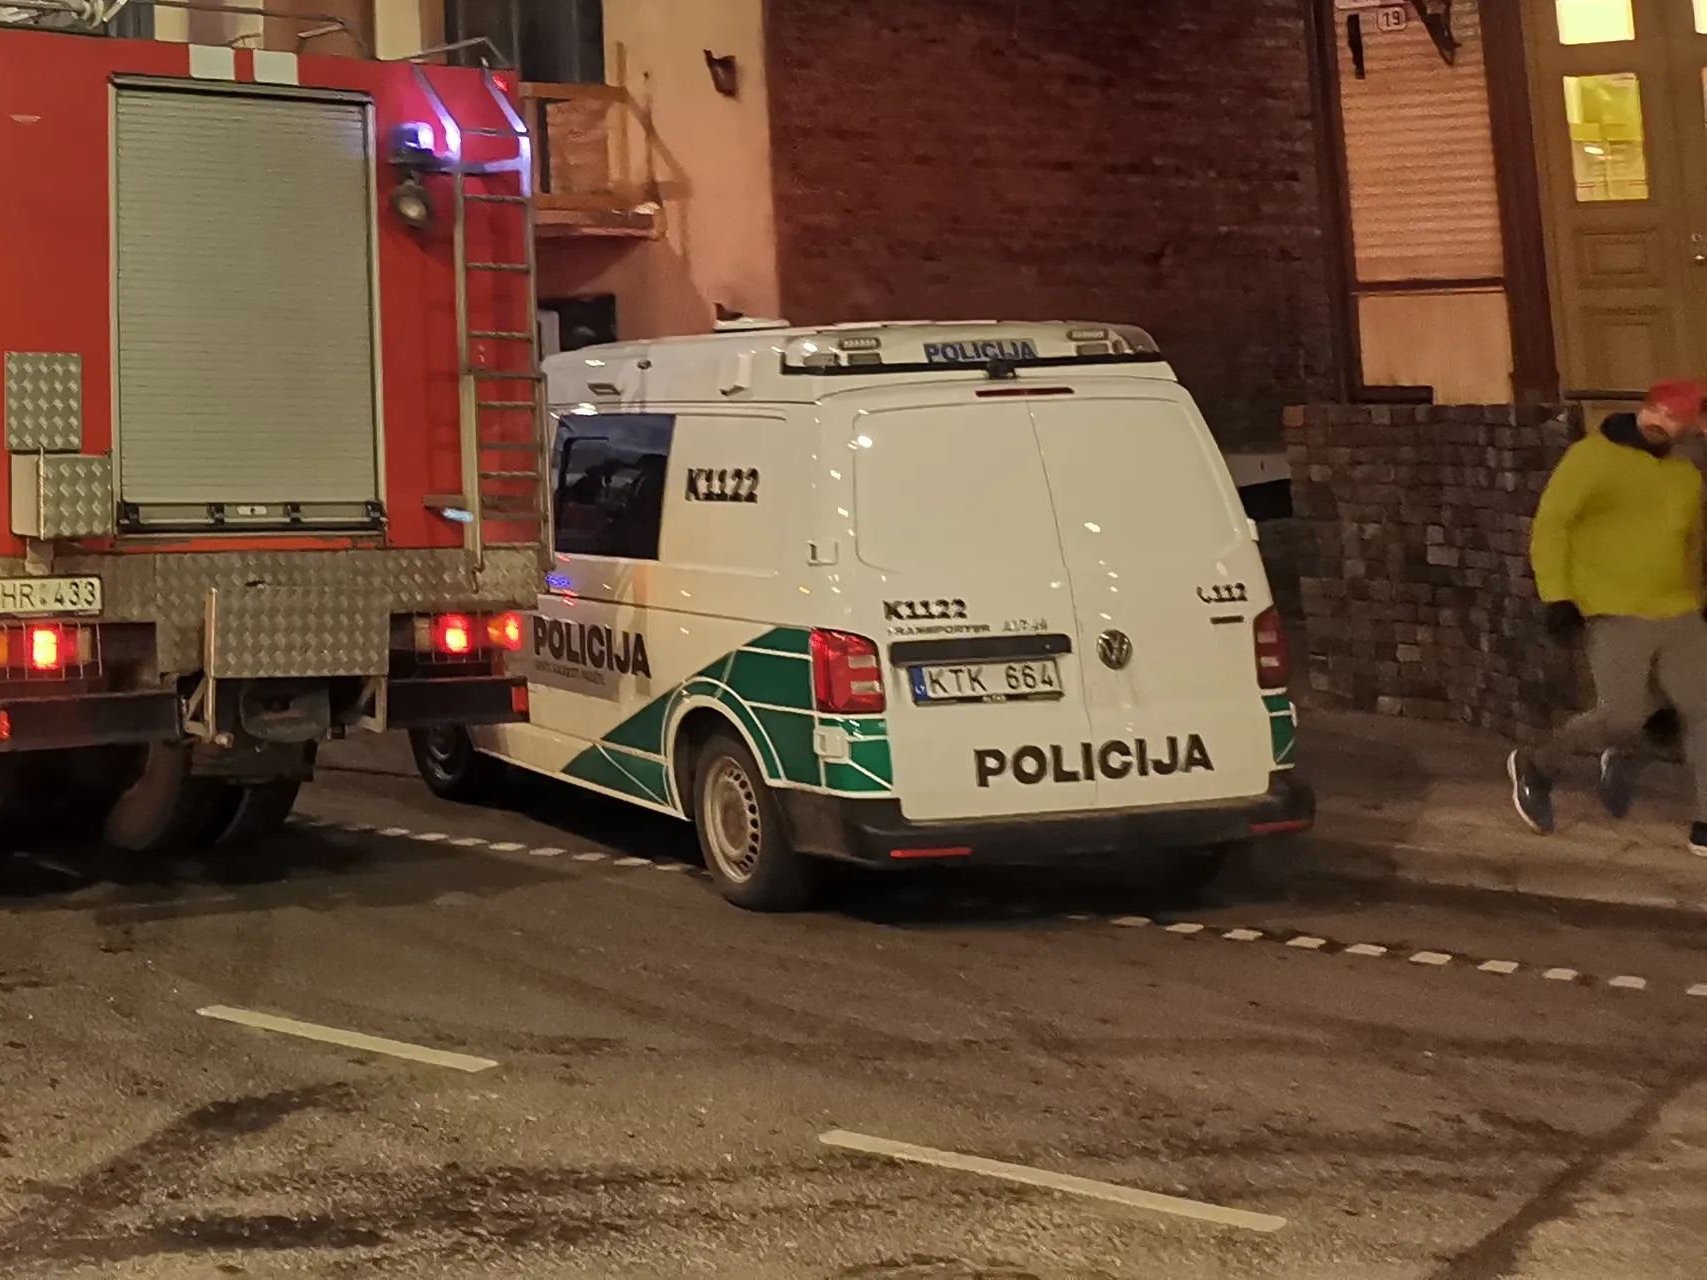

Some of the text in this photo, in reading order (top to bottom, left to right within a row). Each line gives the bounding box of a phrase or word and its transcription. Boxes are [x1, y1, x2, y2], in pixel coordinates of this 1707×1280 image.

[923, 340, 1038, 364] POLICIJA
[685, 468, 759, 504] K1122
[53, 581, 96, 606] 433
[882, 598, 968, 621] K1122
[533, 615, 652, 679] POLICIJA
[928, 662, 1054, 695] KTK 664
[973, 733, 1215, 788] POLICIJA
